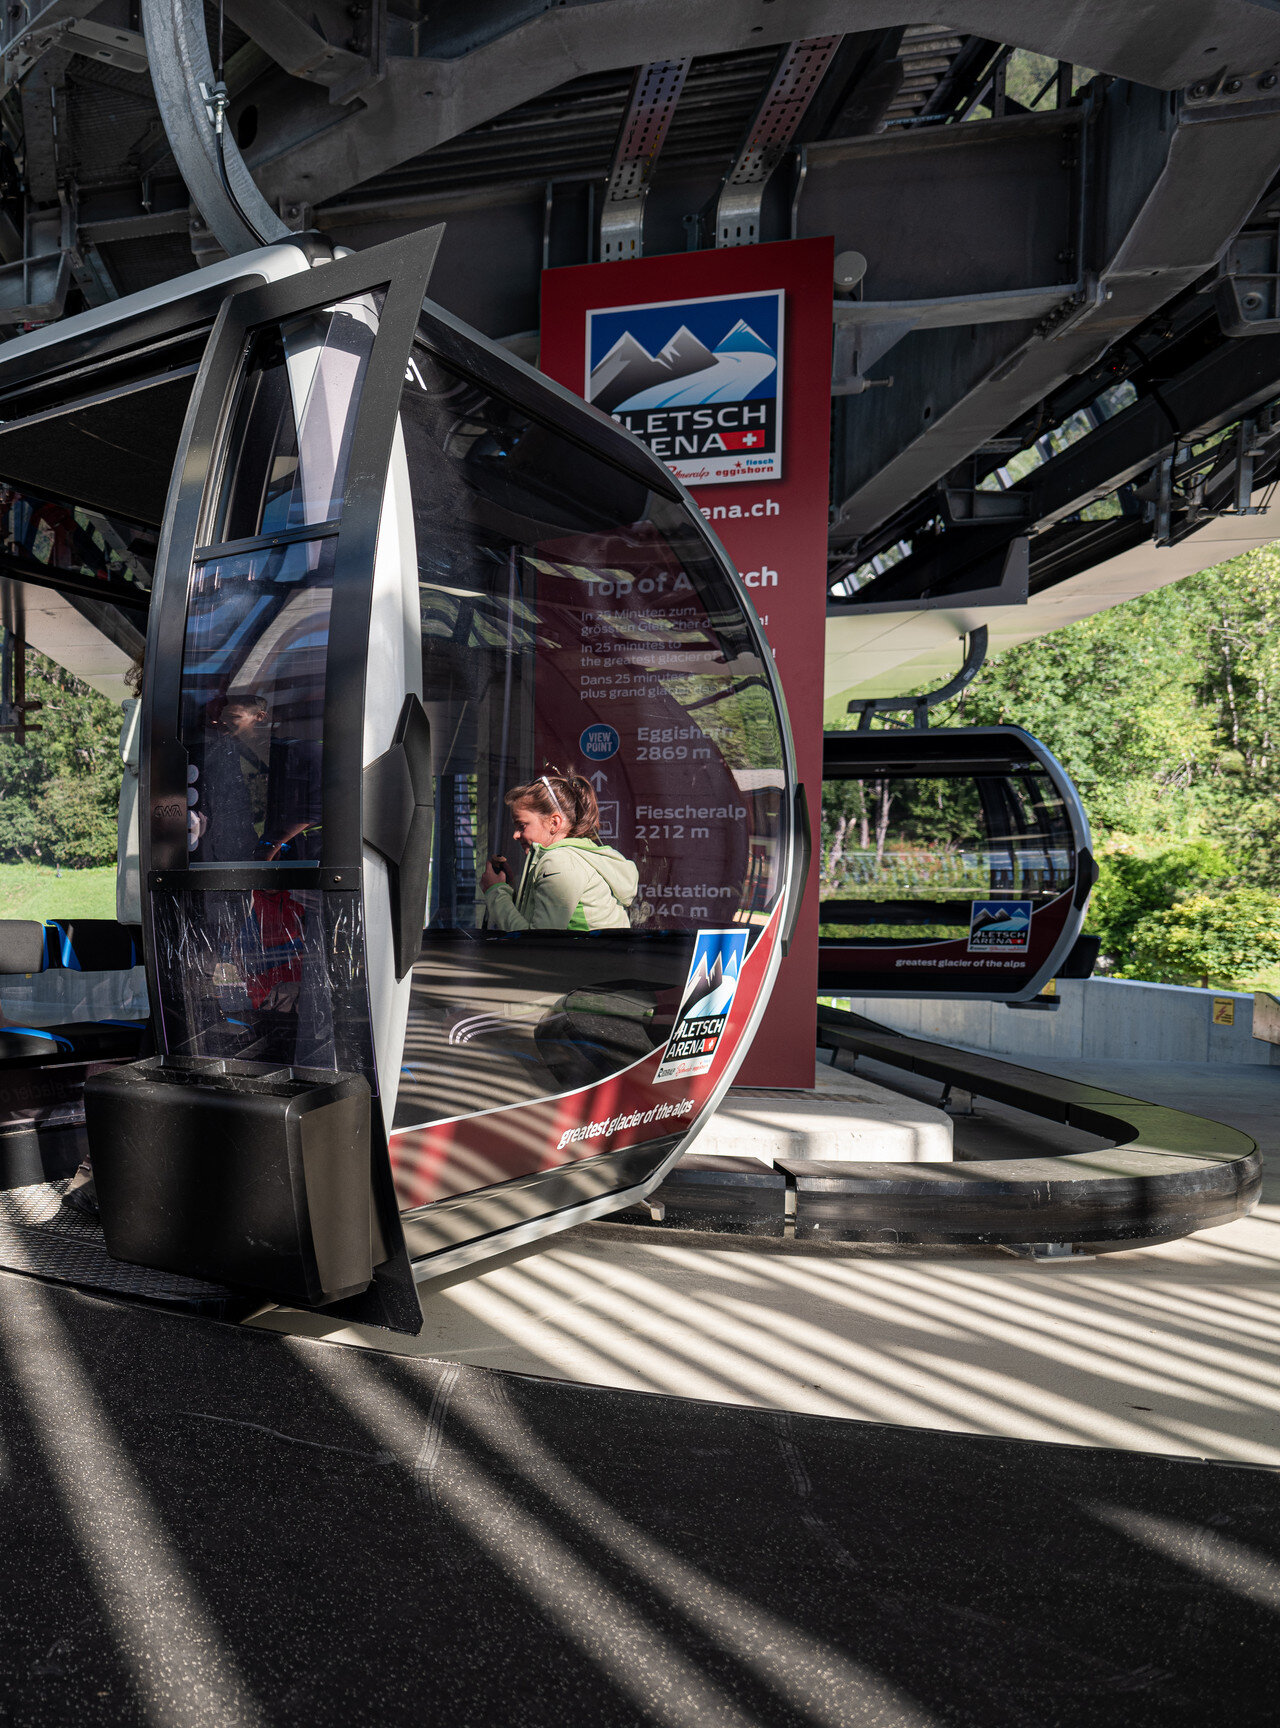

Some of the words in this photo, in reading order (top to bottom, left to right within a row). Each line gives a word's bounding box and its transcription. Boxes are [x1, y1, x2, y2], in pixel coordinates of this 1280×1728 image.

[641, 433, 728, 457] ENA
[746, 458, 774, 466] fiesch
[716, 465, 774, 478] eggishorn
[702, 499, 780, 521] ena.ch
[584, 578, 632, 598] Top
[638, 571, 668, 592] of
[614, 608, 666, 620] Minuten
[668, 607, 697, 617] zum
[581, 644, 593, 653] In
[595, 642, 611, 653] 25
[614, 640, 665, 652] minutes
[668, 640, 682, 649] to
[580, 656, 602, 667] the
[603, 654, 656, 668] greatest
[658, 652, 700, 666] glacier
[580, 675, 613, 686] Dans
[615, 673, 630, 684] 25
[580, 688, 607, 701] plus
[609, 686, 645, 700] grand
[588, 731, 611, 743] VIEW
[586, 741, 613, 753] POINT
[636, 746, 688, 761] 2869
[692, 747, 711, 760] m
[635, 804, 747, 821] Fiescheralp
[635, 824, 684, 839] 2212
[690, 826, 709, 838] m
[636, 884, 732, 899] Talstation
[690, 906, 708, 918] m
[895, 958, 937, 967] greatest
[938, 958, 972, 968] glacier
[972, 958, 985, 967] of
[986, 959, 1001, 968] the
[1003, 960, 1026, 969] alps
[673, 1018, 725, 1041] ALETSCH
[666, 1039, 706, 1059] ARENA
[556, 1117, 610, 1150] greatest
[605, 1109, 646, 1137] glacier
[643, 1104, 660, 1124] of
[655, 1102, 674, 1121] the
[671, 1097, 695, 1118] alps
